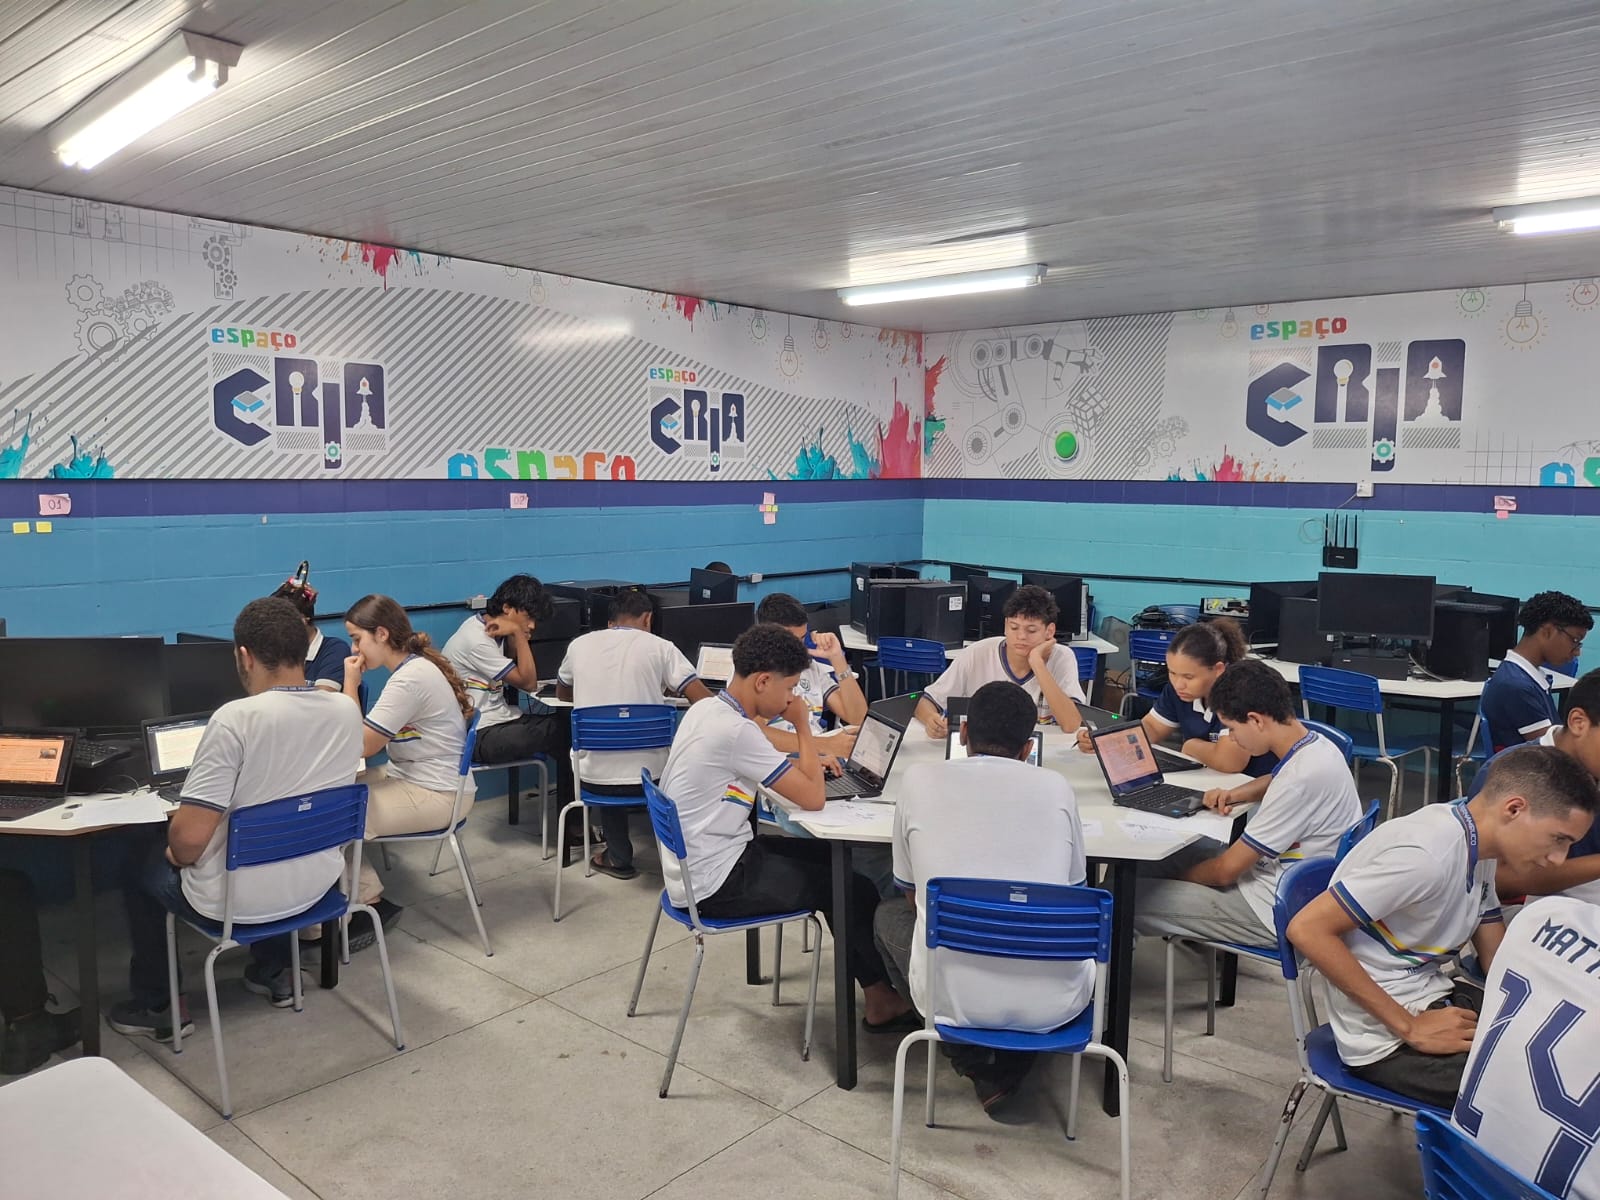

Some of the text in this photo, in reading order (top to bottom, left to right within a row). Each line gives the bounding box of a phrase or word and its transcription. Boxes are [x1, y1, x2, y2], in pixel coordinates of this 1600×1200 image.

[211, 327, 297, 352] espaço
[1250, 317, 1347, 341] espaço
[649, 367, 696, 385] espaço
[48, 499, 62, 510] 01
